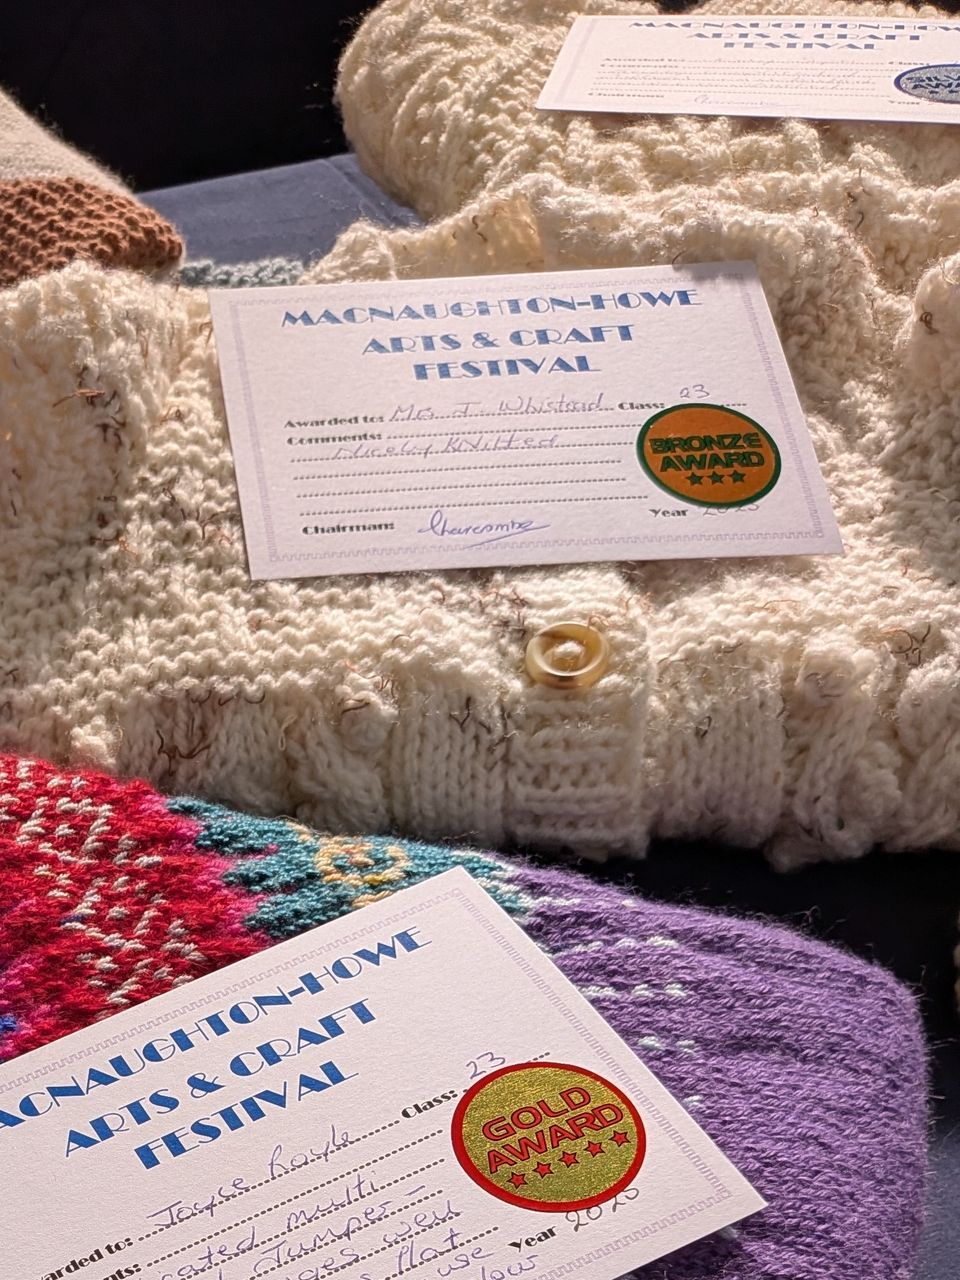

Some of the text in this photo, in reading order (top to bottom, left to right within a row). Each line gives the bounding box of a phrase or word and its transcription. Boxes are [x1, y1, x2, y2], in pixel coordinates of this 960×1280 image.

[629, 22, 960, 31] MACNAUGHTON-HOW
[281, 289, 703, 328] MACNAUGHTON-HOWE
[362, 324, 636, 356] ARTS & CRAFT
[413, 355, 602, 381] FESTIVAL
[680, 384, 710, 399] 23
[618, 401, 665, 411] Class:
[284, 416, 359, 429] Awarded
[286, 433, 382, 446] Comments:
[649, 432, 763, 454] BRONZE
[660, 450, 766, 473] AWARD
[649, 508, 689, 518] Year
[302, 520, 395, 536] Chairman:
[65, 998, 377, 1158] ARTS & CRAFT
[465, 1051, 507, 1081] 23
[134, 1060, 360, 1170] FESTIVAL
[400, 1089, 459, 1120] Class:
[482, 1086, 592, 1142] GOLD
[487, 1102, 625, 1175] AWARD
[105, 1236, 134, 1255] to:
[506, 1225, 560, 1253] Year
